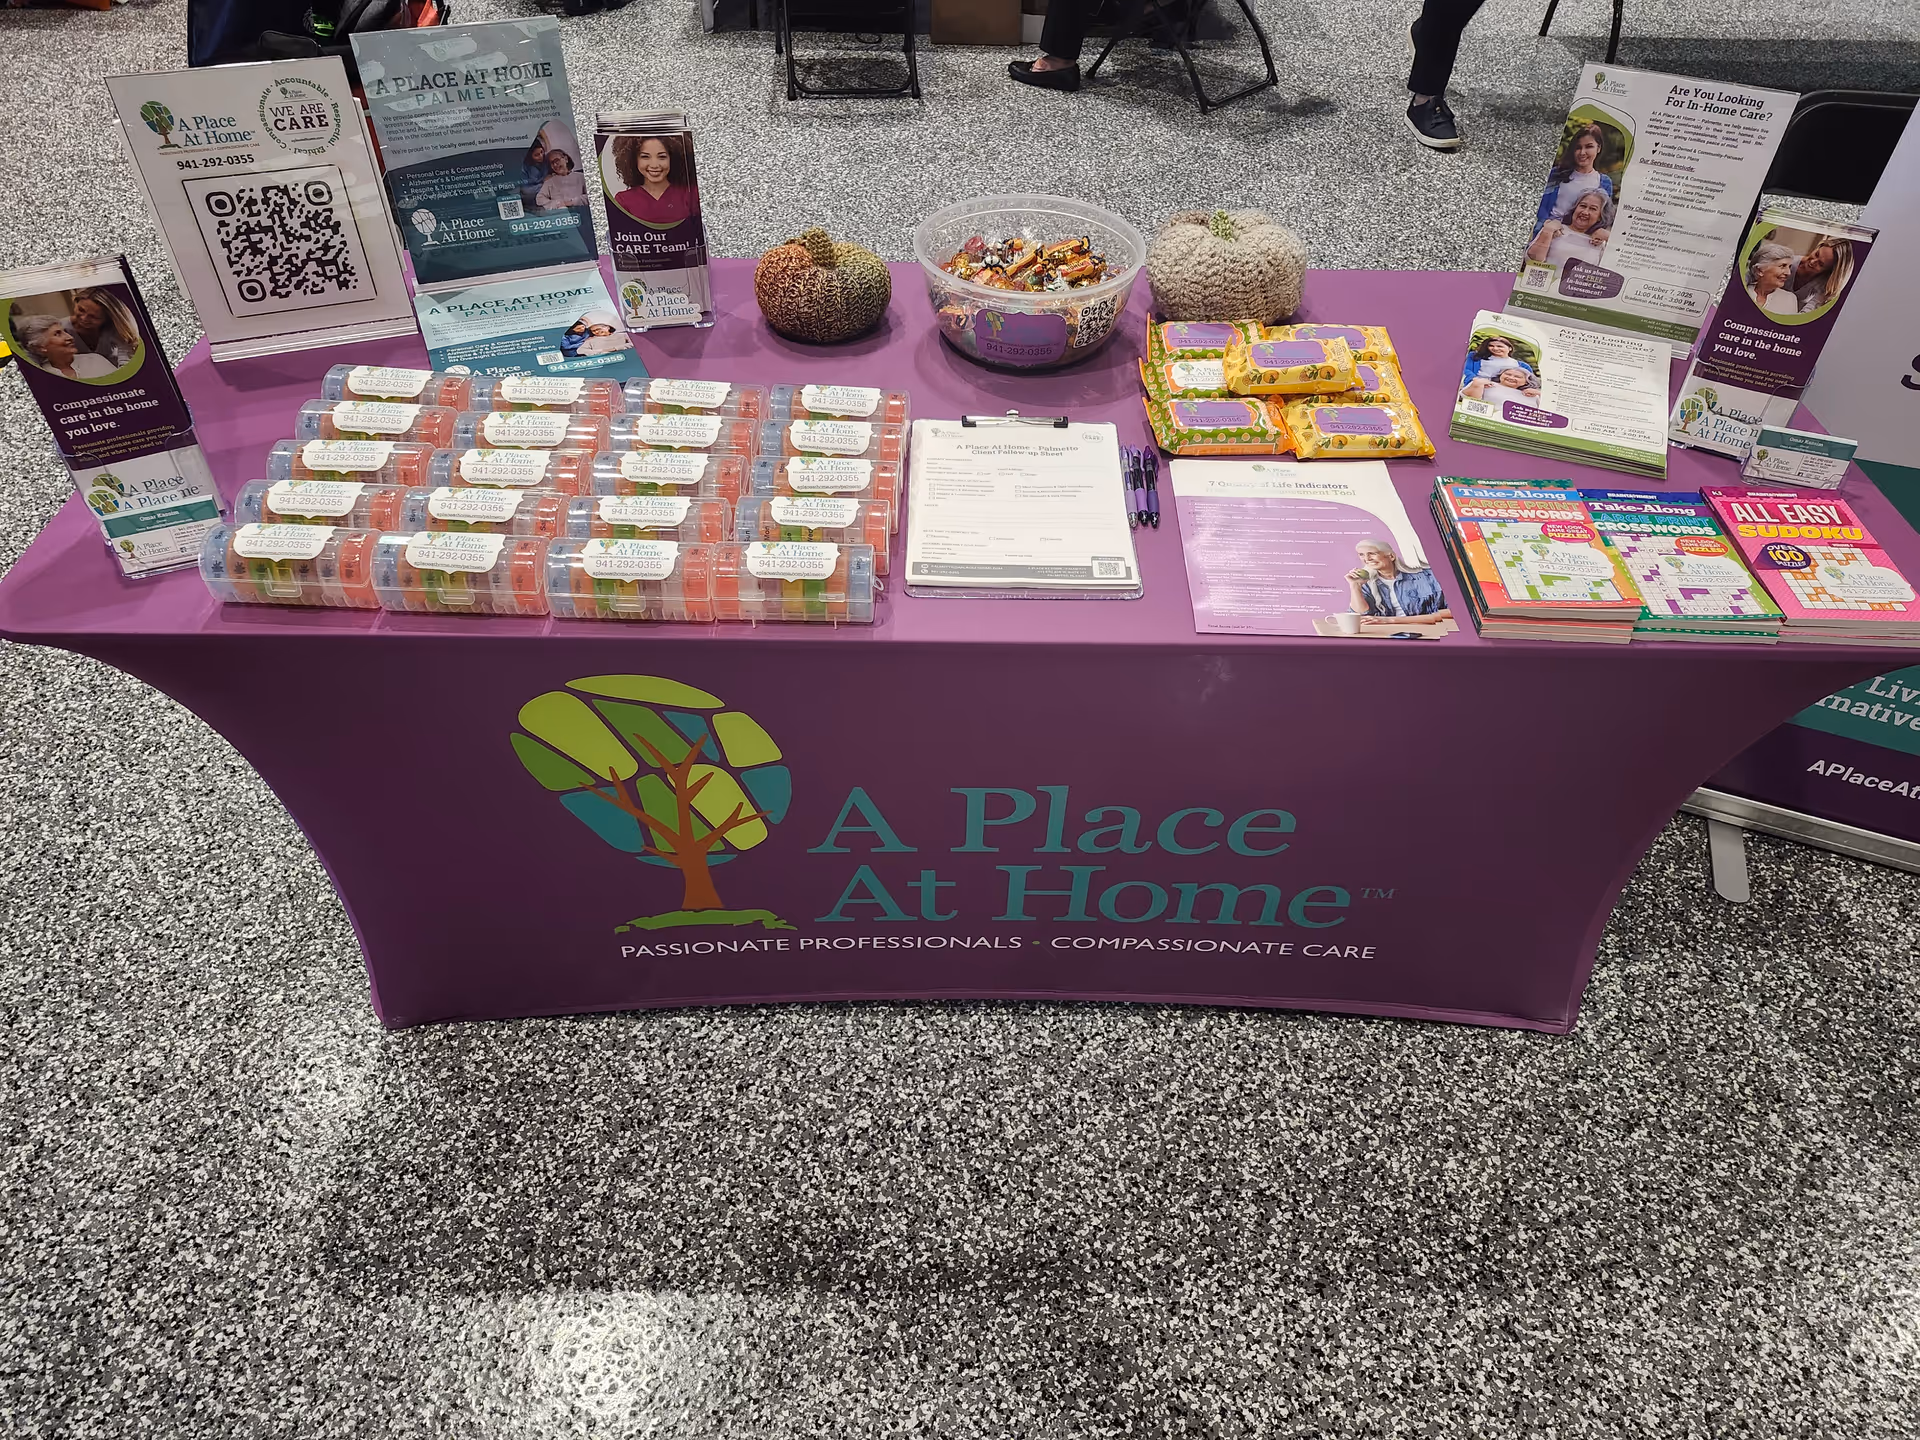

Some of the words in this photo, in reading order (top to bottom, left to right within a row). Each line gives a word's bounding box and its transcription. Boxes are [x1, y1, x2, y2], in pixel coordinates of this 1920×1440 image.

[376, 79, 390, 95] A
[392, 72, 458, 93] PLACE
[464, 69, 489, 85] AT
[491, 62, 553, 83] HOME
[274, 77, 329, 98] Accountable
[1669, 85, 1689, 96] Are
[1694, 88, 1714, 101] You
[1717, 91, 1764, 110] Looking
[269, 105, 293, 117] WE
[299, 102, 325, 114] ARE
[1665, 96, 1685, 108] For
[1687, 97, 1737, 117] In-Home
[1739, 107, 1772, 122] Care?
[178, 118, 192, 131] A
[194, 115, 237, 130] Place
[258, 88, 288, 149] Compassionate
[273, 114, 329, 131] CARE
[328, 102, 341, 147] Respectful
[184, 132, 207, 147] At
[209, 130, 252, 145] Home
[293, 145, 326, 157] Ethical
[177, 154, 254, 170] 941-292-0355
[407, 170, 433, 180] Personal
[435, 168, 450, 177] Care
[457, 163, 503, 175] Companionship
[451, 173, 479, 182] Dementia
[481, 169, 504, 180] Support
[440, 180, 478, 191] Transitional
[479, 179, 492, 187] Care
[439, 221, 451, 232] A
[451, 216, 485, 230] Place
[511, 216, 580, 233] 941-292-0355
[441, 231, 455, 243] At
[457, 228, 495, 242] Home
[614, 231, 642, 242] Join
[644, 231, 667, 241] Our
[616, 243, 650, 254] CARE
[653, 240, 690, 253] Team!
[1643, 283, 1669, 295] October
[1676, 290, 1693, 299] 2025
[429, 307, 442, 316] A
[446, 299, 506, 312] PLACE
[510, 295, 536, 306] AT
[538, 286, 594, 301] HOME
[645, 298, 654, 307] A
[656, 296, 686, 306] Place
[1652, 292, 1665, 301] AM
[1683, 299, 1696, 308] PM
[465, 298, 569, 318] PALMETTO
[647, 308, 660, 318] At
[661, 306, 694, 317] Home
[1723, 319, 1801, 344] Compassionate
[985, 342, 1052, 357] 941-292-0355
[1713, 342, 1733, 354] you
[1733, 345, 1757, 360] love.
[1718, 331, 1740, 343] care
[1742, 335, 1753, 346] in
[1753, 338, 1770, 351] the
[1772, 342, 1802, 357] home
[550, 354, 624, 371] 941-292-0355
[357, 378, 415, 390] 941-292-0355
[53, 387, 146, 412] Compassionate
[811, 397, 868, 409] 941-292-0355
[59, 412, 87, 425] care
[87, 409, 102, 420] in
[103, 405, 124, 417] the
[126, 398, 159, 413] home
[65, 425, 90, 440] you
[90, 420, 121, 433] love.
[495, 428, 556, 439] 941-292-0355
[648, 428, 708, 439] 941-292-0355
[1698, 417, 1709, 427] A
[1712, 417, 1748, 437] Place
[1694, 428, 1711, 439] At
[1712, 430, 1752, 449] Home
[313, 453, 377, 463] 941-292-0355
[997, 449, 1039, 458] Follow-up
[129, 484, 139, 494] A
[142, 475, 186, 493] Place
[799, 473, 860, 483] 941-292-0355
[1294, 482, 1349, 490] Indicators
[123, 501, 134, 511] A
[137, 493, 178, 508] Place
[278, 496, 344, 507] 941-292-0355
[1458, 488, 1567, 501] Take-Along
[440, 501, 505, 513] 941-292-0355
[1455, 498, 1521, 510] LARGE
[1523, 500, 1580, 511] PRINT
[1589, 502, 1696, 517] Take-Along
[611, 507, 676, 518] 941-292-0355
[783, 509, 846, 519] 941-292-0355
[1460, 508, 1586, 521] CROSSWORDS
[1590, 512, 1653, 524] LARGE
[1654, 515, 1710, 527] PRINT
[1730, 502, 1781, 523] ALL
[1777, 504, 1843, 525] EASY
[1593, 522, 1717, 537] CROSSWORDS
[1736, 524, 1864, 541] SUDOKU
[245, 538, 313, 550] 941-292-0355
[1766, 544, 1798, 552] OVER
[417, 549, 486, 563] 941-292-0355
[1769, 549, 1804, 563] 100
[595, 559, 662, 570] 941-292-0355
[758, 559, 825, 570] 941-292-0355
[806, 787, 918, 853] A
[950, 785, 1298, 856] Place
[814, 864, 958, 922] At
[991, 865, 1352, 929] Home
[621, 938, 790, 957] PASSIONATE
[799, 936, 1022, 950] PROFESSIONALS
[1056, 936, 1295, 957] COMPASSIONATE
[1302, 943, 1377, 960] CARE
